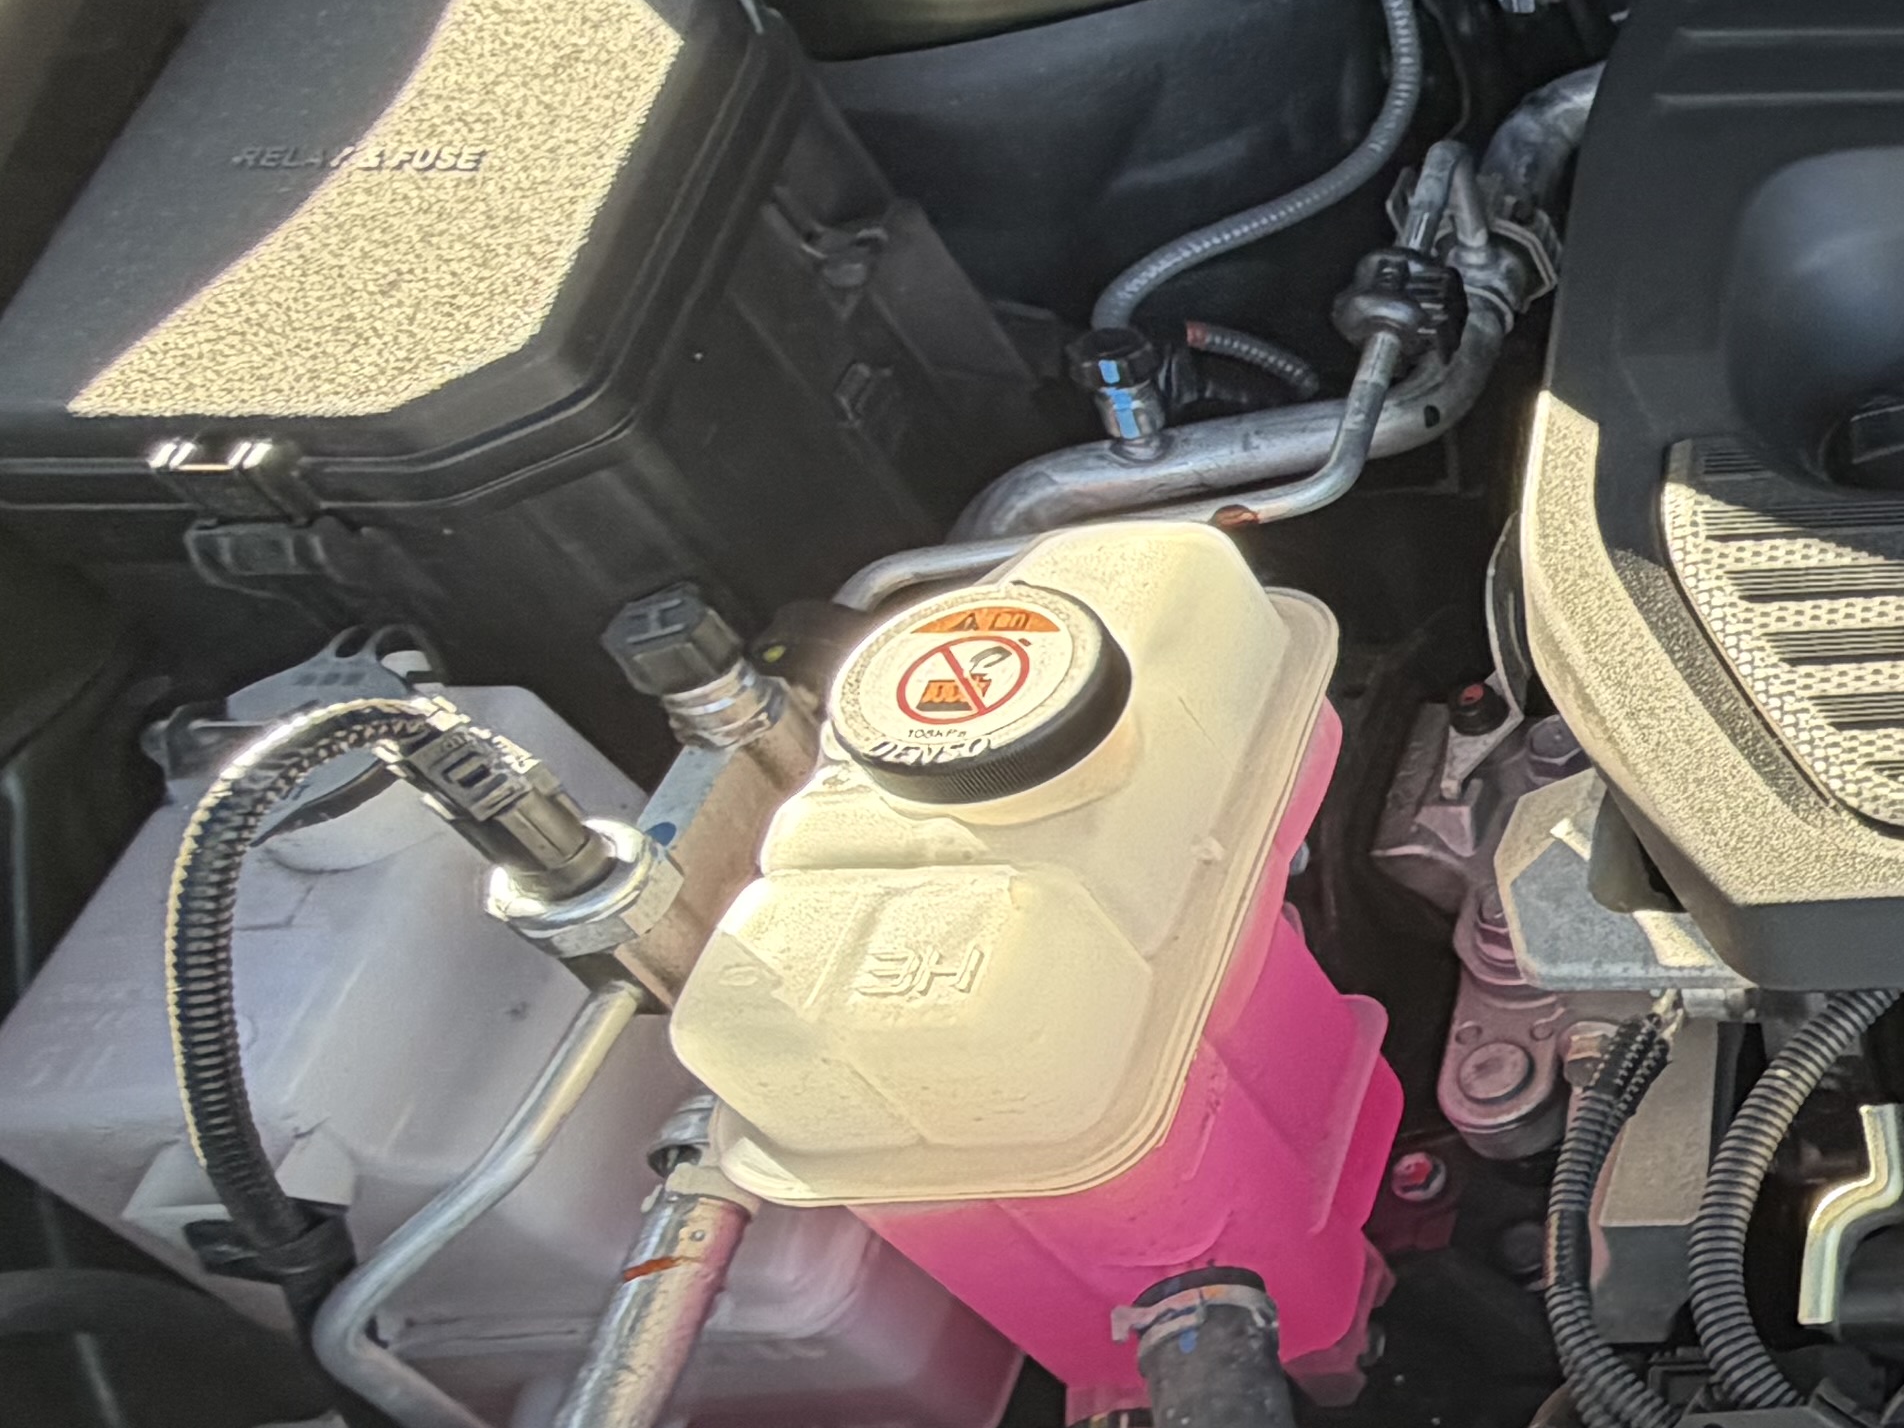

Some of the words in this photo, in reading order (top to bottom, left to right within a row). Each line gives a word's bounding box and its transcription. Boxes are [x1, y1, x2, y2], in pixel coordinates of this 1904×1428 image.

[231, 146, 354, 169] RELAY
[391, 147, 485, 171] FUSE
[864, 738, 991, 766] DENSO
